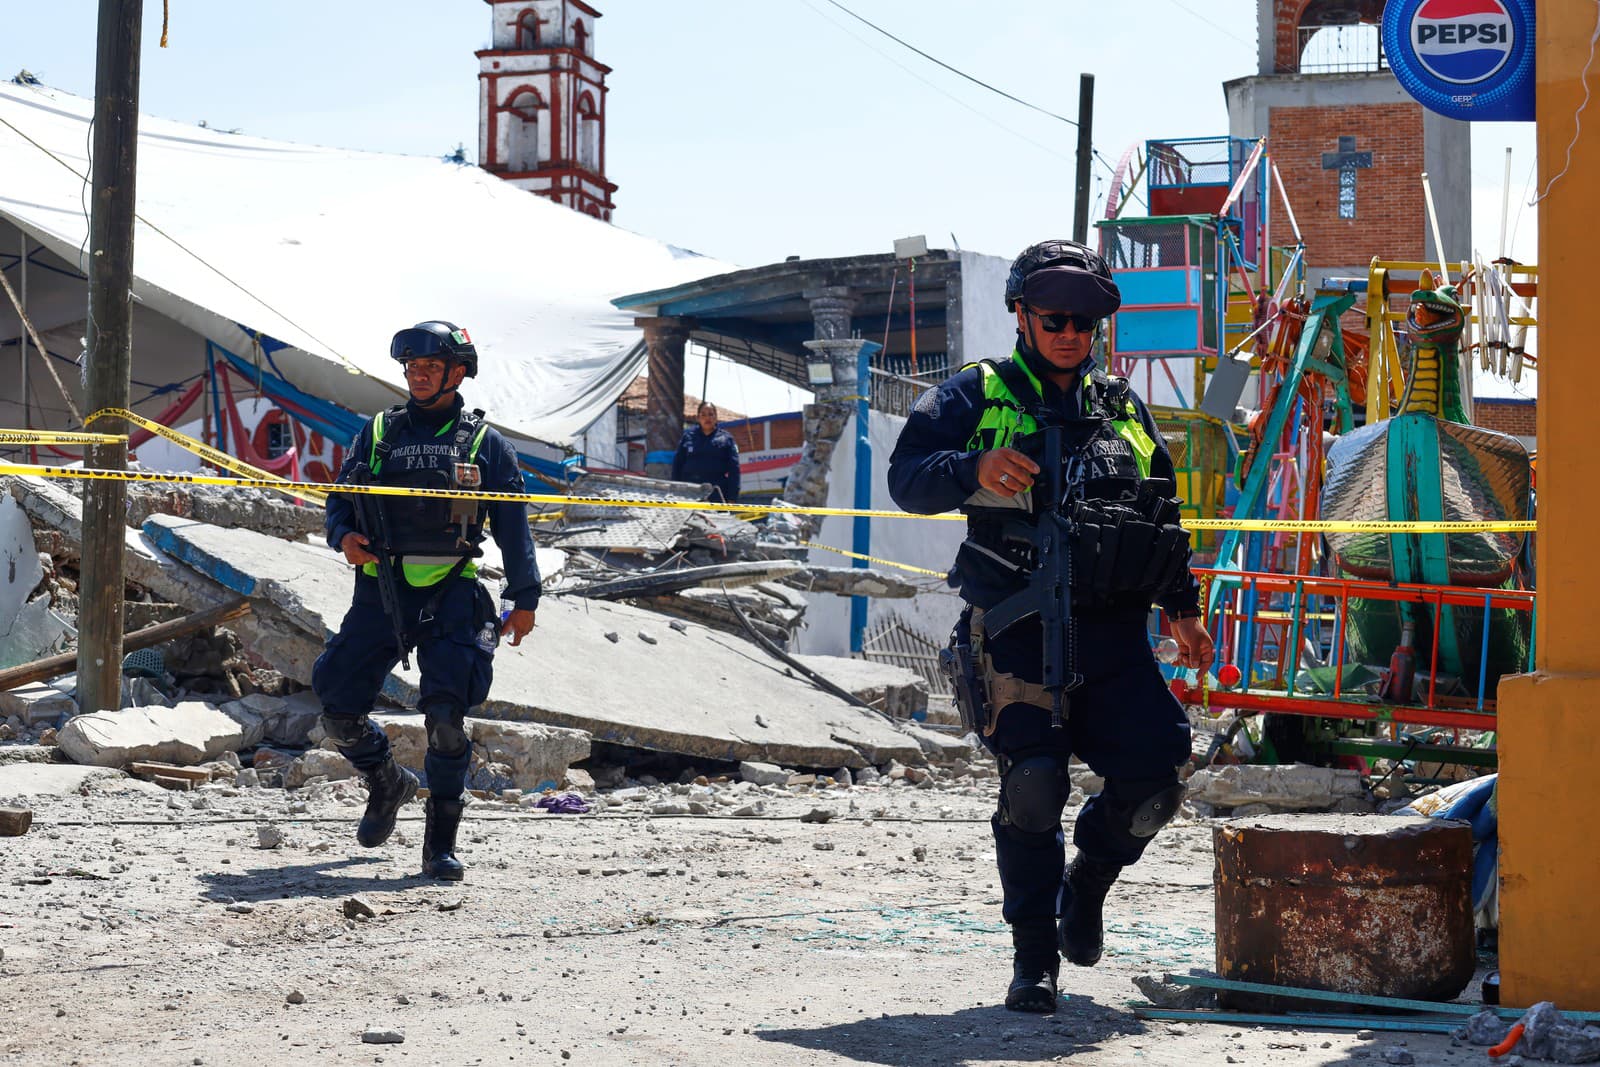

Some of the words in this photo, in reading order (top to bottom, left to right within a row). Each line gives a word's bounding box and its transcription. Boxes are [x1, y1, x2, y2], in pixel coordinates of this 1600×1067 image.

[1417, 23, 1507, 45] PEPSI
[1451, 95, 1472, 103] GEPP
[389, 444, 421, 460] POLICIA
[423, 444, 460, 457] ESTATAL
[1091, 439, 1131, 457] ESTATAL
[405, 455, 439, 470] FAR
